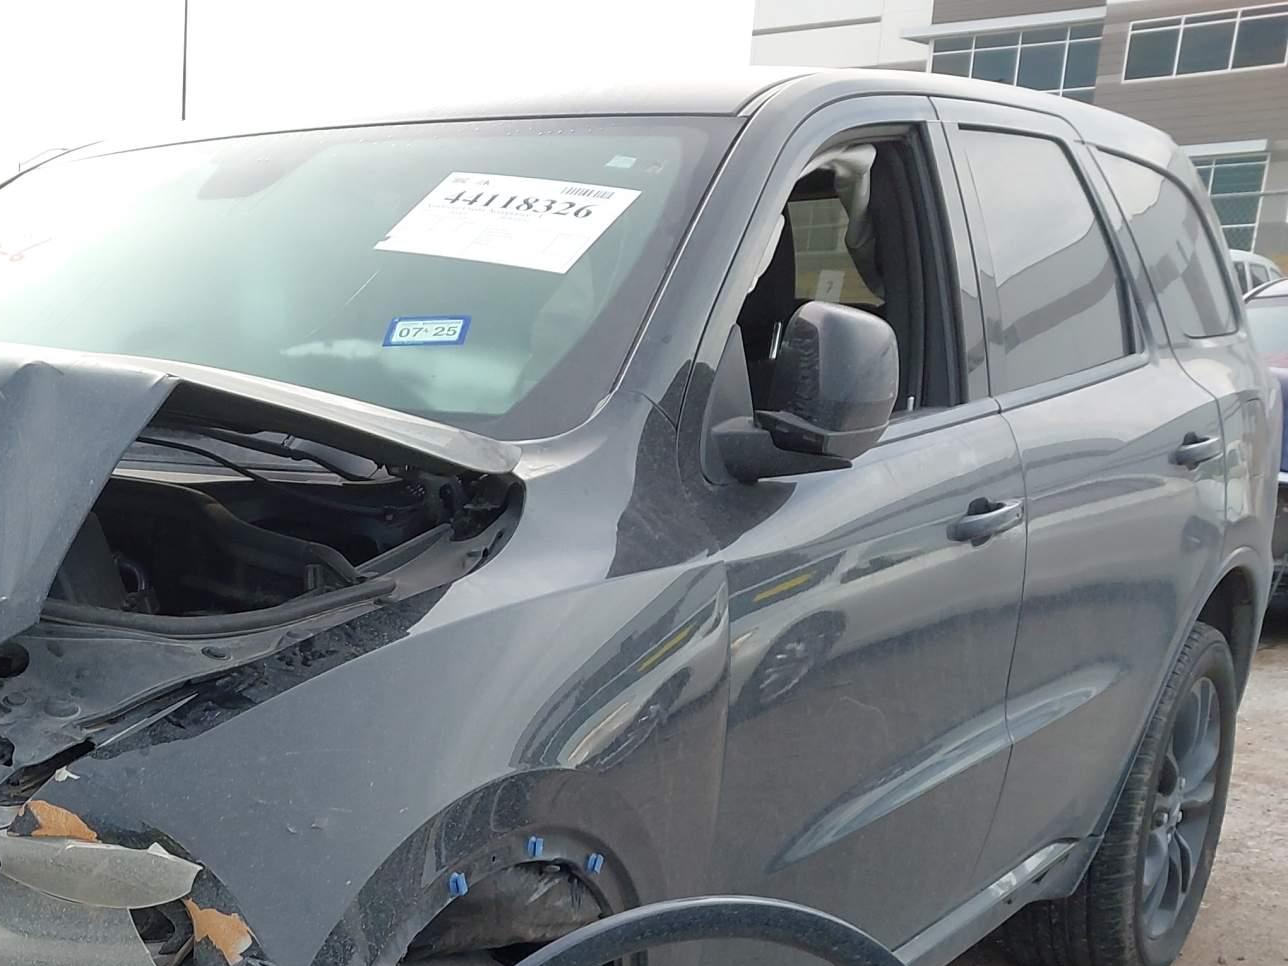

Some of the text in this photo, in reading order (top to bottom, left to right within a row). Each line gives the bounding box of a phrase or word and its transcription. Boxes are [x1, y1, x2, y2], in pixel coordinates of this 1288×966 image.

[443, 190, 598, 219] 44118326
[398, 326, 459, 338] 07 25
